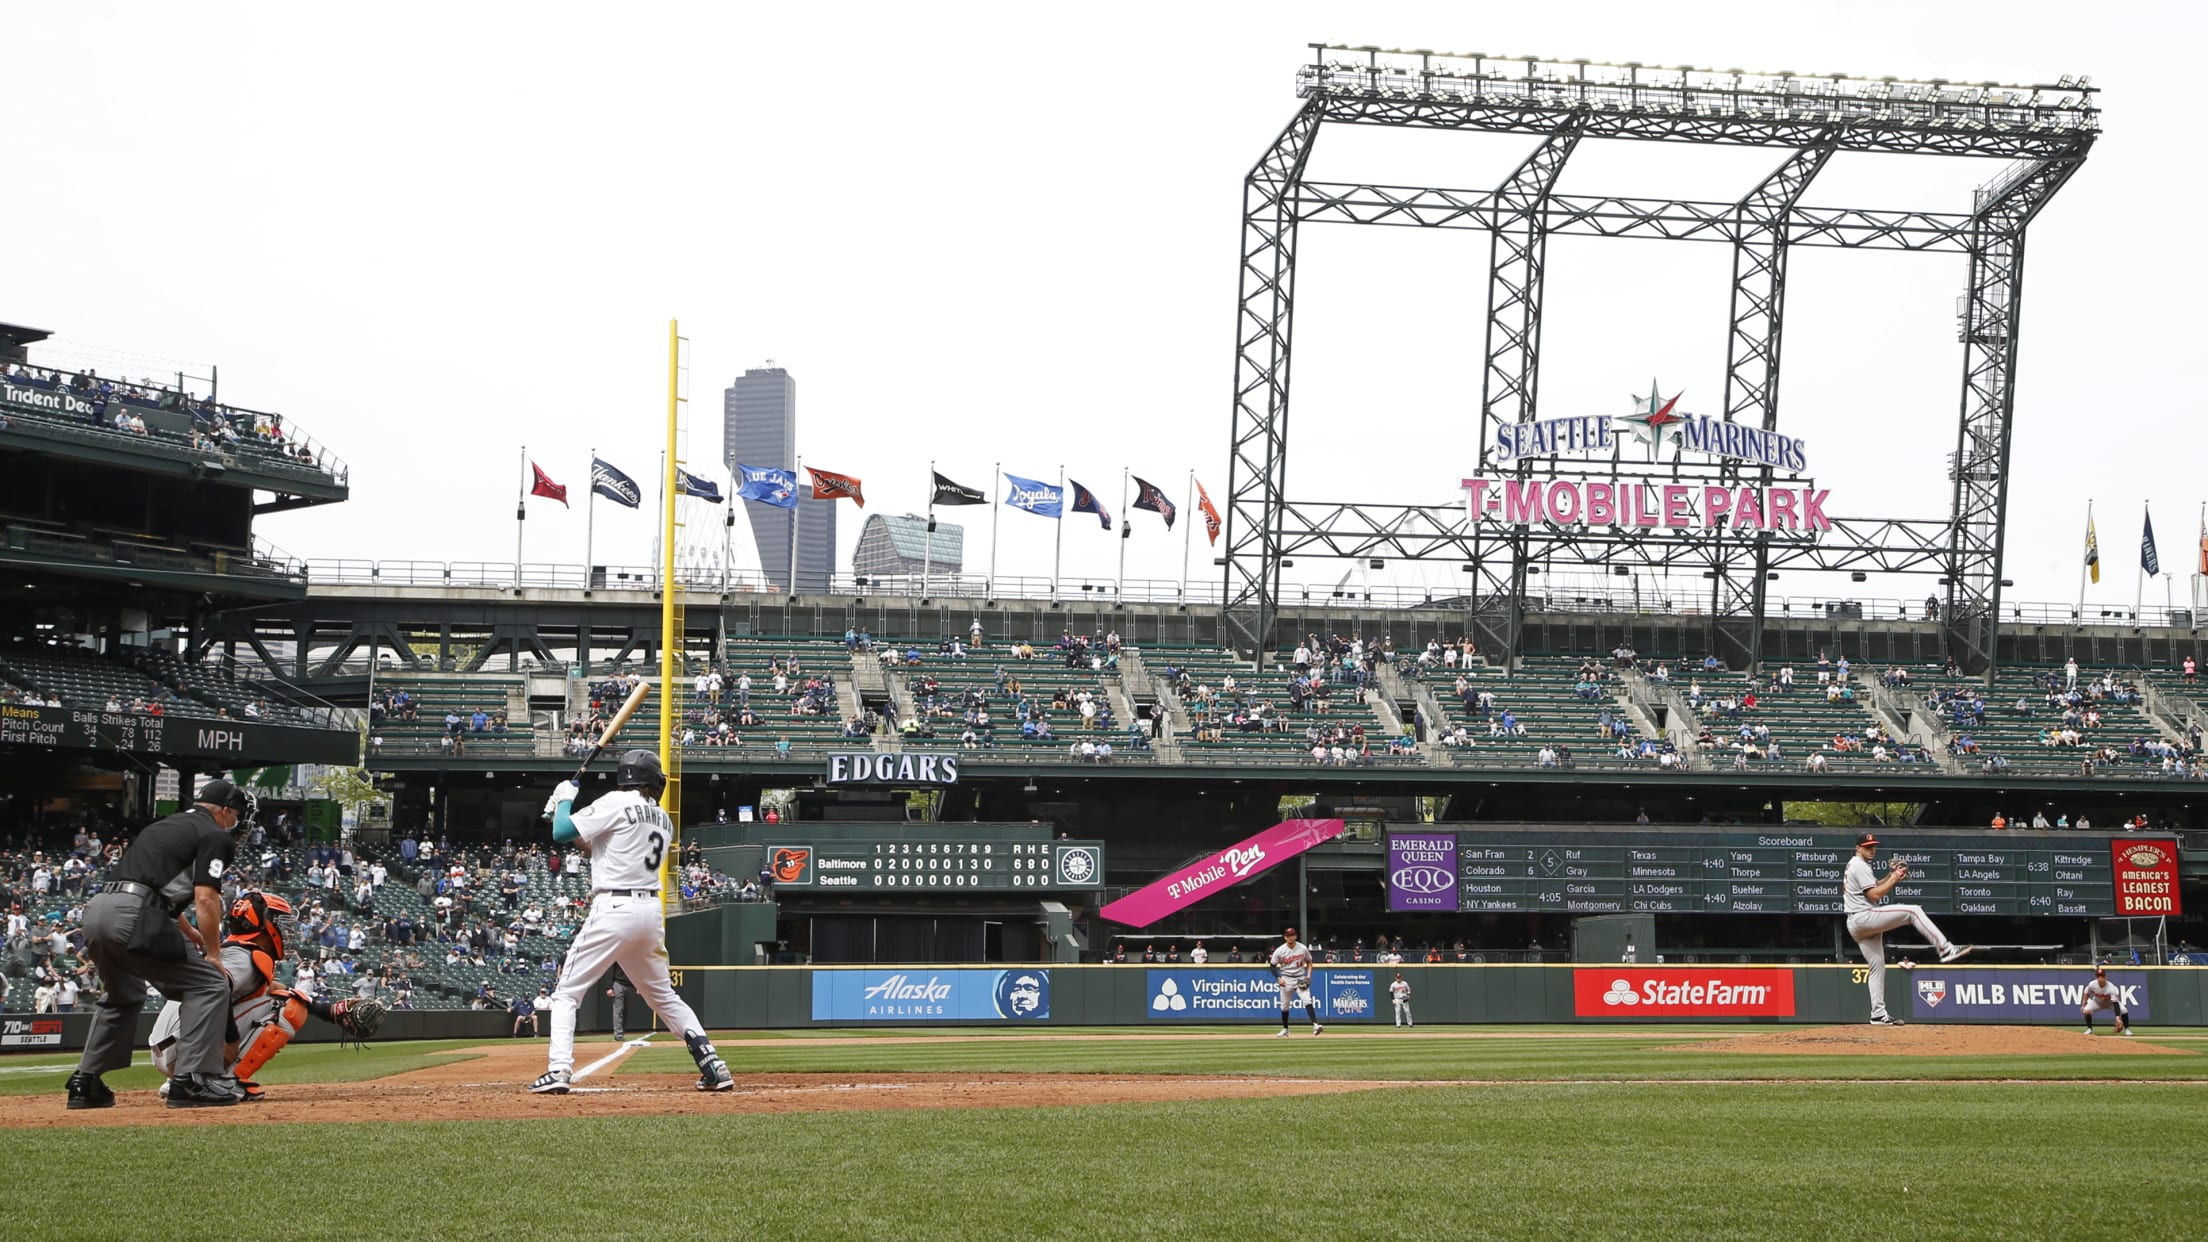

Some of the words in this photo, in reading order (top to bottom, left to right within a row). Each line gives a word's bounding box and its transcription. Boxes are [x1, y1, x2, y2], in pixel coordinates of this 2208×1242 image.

[3, 384, 60, 408] Trident
[65, 396, 94, 415] Dec
[1497, 413, 1614, 463] SEATTLE
[1680, 411, 1806, 473] MARINERS
[592, 463, 639, 503] Yankees
[937, 483, 963, 495] WHIT
[1460, 477, 1692, 529] T-MOBILE
[1702, 482, 1832, 533] PARK
[2, 706, 40, 719] Means
[73, 711, 98, 723] Balls
[101, 713, 137, 726] Strikes
[139, 716, 164, 729] Total
[2, 718, 29, 730] Pitch
[33, 720, 64, 733] Count
[83, 724, 97, 735] 34
[121, 727, 135, 738] 78
[144, 729, 162, 741] 112
[1, 730, 25, 742] First
[29, 732, 56, 744] Pitch
[89, 736, 97, 748] 2
[121, 739, 134, 750] 24
[148, 741, 161, 752] 26
[198, 729, 244, 751] MPH
[829, 753, 958, 784] EDGAR'S
[1391, 839, 1454, 851] EMERALD
[1758, 836, 1813, 846] Scoreboard
[644, 830, 664, 872] 3
[875, 844, 881, 854] 1
[889, 844, 896, 854] 2
[902, 844, 909, 854] 3
[916, 844, 923, 854] 4
[930, 844, 937, 854] 5
[943, 844, 950, 854] 6
[957, 844, 964, 854] 7
[971, 844, 977, 854] 8
[984, 844, 991, 854] 9
[1013, 844, 1021, 854] R
[1027, 844, 1035, 854] H
[1041, 844, 1049, 854] E
[1465, 850, 1484, 859] San
[1487, 850, 1505, 859] Fran
[1527, 851, 1534, 859] 2
[1566, 850, 1581, 859] Ruf
[1401, 851, 1444, 864] QUEEN
[1547, 857, 1554, 867] 5
[1631, 851, 1656, 860] Texas
[1730, 852, 1752, 863] Yang
[1795, 853, 1838, 863] Pittsburgh
[1957, 853, 1986, 864] Tampa
[1988, 854, 2005, 864] Bay
[2054, 855, 2092, 865] Kittredge
[818, 858, 867, 869] Baltimore
[874, 858, 882, 870] 0
[888, 858, 896, 870] 2
[902, 858, 910, 870] 0
[915, 858, 923, 870] 0
[929, 858, 937, 870] 0
[943, 858, 951, 870] 0
[958, 858, 963, 870] 1
[970, 858, 978, 870] 3
[984, 858, 992, 870] 0
[1014, 858, 1021, 870] 6
[1027, 858, 1035, 870] 8
[1041, 858, 1049, 870] 0
[1703, 859, 1724, 868] 4:40
[1872, 861, 1887, 870] :10
[2027, 862, 2049, 872] 6:38
[1466, 866, 1505, 875] Colorado
[1566, 867, 1588, 877] Gray
[1632, 867, 1676, 877] Minnesota
[1731, 868, 1761, 879] Thorpe
[1796, 869, 1814, 877] San
[1815, 869, 1840, 880] Diego
[1959, 870, 1970, 879] LA
[1971, 870, 2000, 881] Angels
[2055, 871, 2083, 880] Ohtani
[2122, 871, 2169, 880] AMERICA'S
[819, 875, 858, 886] Seattle
[874, 875, 882, 886] 0
[888, 875, 896, 886] 0
[902, 875, 910, 886] 0
[915, 875, 923, 886] 0
[929, 875, 937, 886] 0
[943, 875, 951, 886] 0
[956, 875, 964, 886] 0
[970, 875, 978, 886] 0
[1013, 875, 1021, 886] 0
[1027, 875, 1035, 886] 0
[1041, 875, 1049, 886] 0
[1399, 869, 1449, 894] EQC
[1466, 884, 1502, 893] Houston
[1566, 885, 1595, 894] Garcia
[1633, 885, 1645, 894] LA
[1647, 885, 1683, 896] Dodgers
[1732, 886, 1763, 895] Buehler
[1797, 886, 1838, 895] Cleveland
[1895, 887, 1922, 896] Bieber
[1959, 887, 1991, 896] Toronto
[2057, 888, 2074, 898] Ray
[2122, 882, 2170, 894] LEANEST
[1539, 892, 1561, 902] 4:05
[1704, 893, 1726, 903] 4:40
[2030, 897, 2051, 906] 6:40
[1467, 900, 1479, 909] NY
[1480, 900, 1517, 909] Yankees
[1567, 901, 1621, 911] Montgomery
[1633, 901, 1647, 910] Chi
[1649, 901, 1672, 910] Cubs
[1798, 902, 1829, 911] Kansas
[1831, 902, 1844, 911] Cit
[1961, 904, 1996, 913] Oakland
[2058, 904, 2086, 913] Bassitt
[2124, 896, 2172, 911] BACON
[669, 971, 683, 986] 31
[1851, 968, 1869, 984] 37
[864, 974, 951, 1000] Alaska
[1192, 979, 1246, 996] Virginia
[1250, 980, 1280, 993] Mas
[1955, 984, 2006, 1005] MLB
[2012, 984, 2140, 1006] NETWK
[1193, 996, 1271, 1009] Franciscan
[869, 1005, 943, 1015] AIRLINES
[3, 1020, 22, 1034] 710
